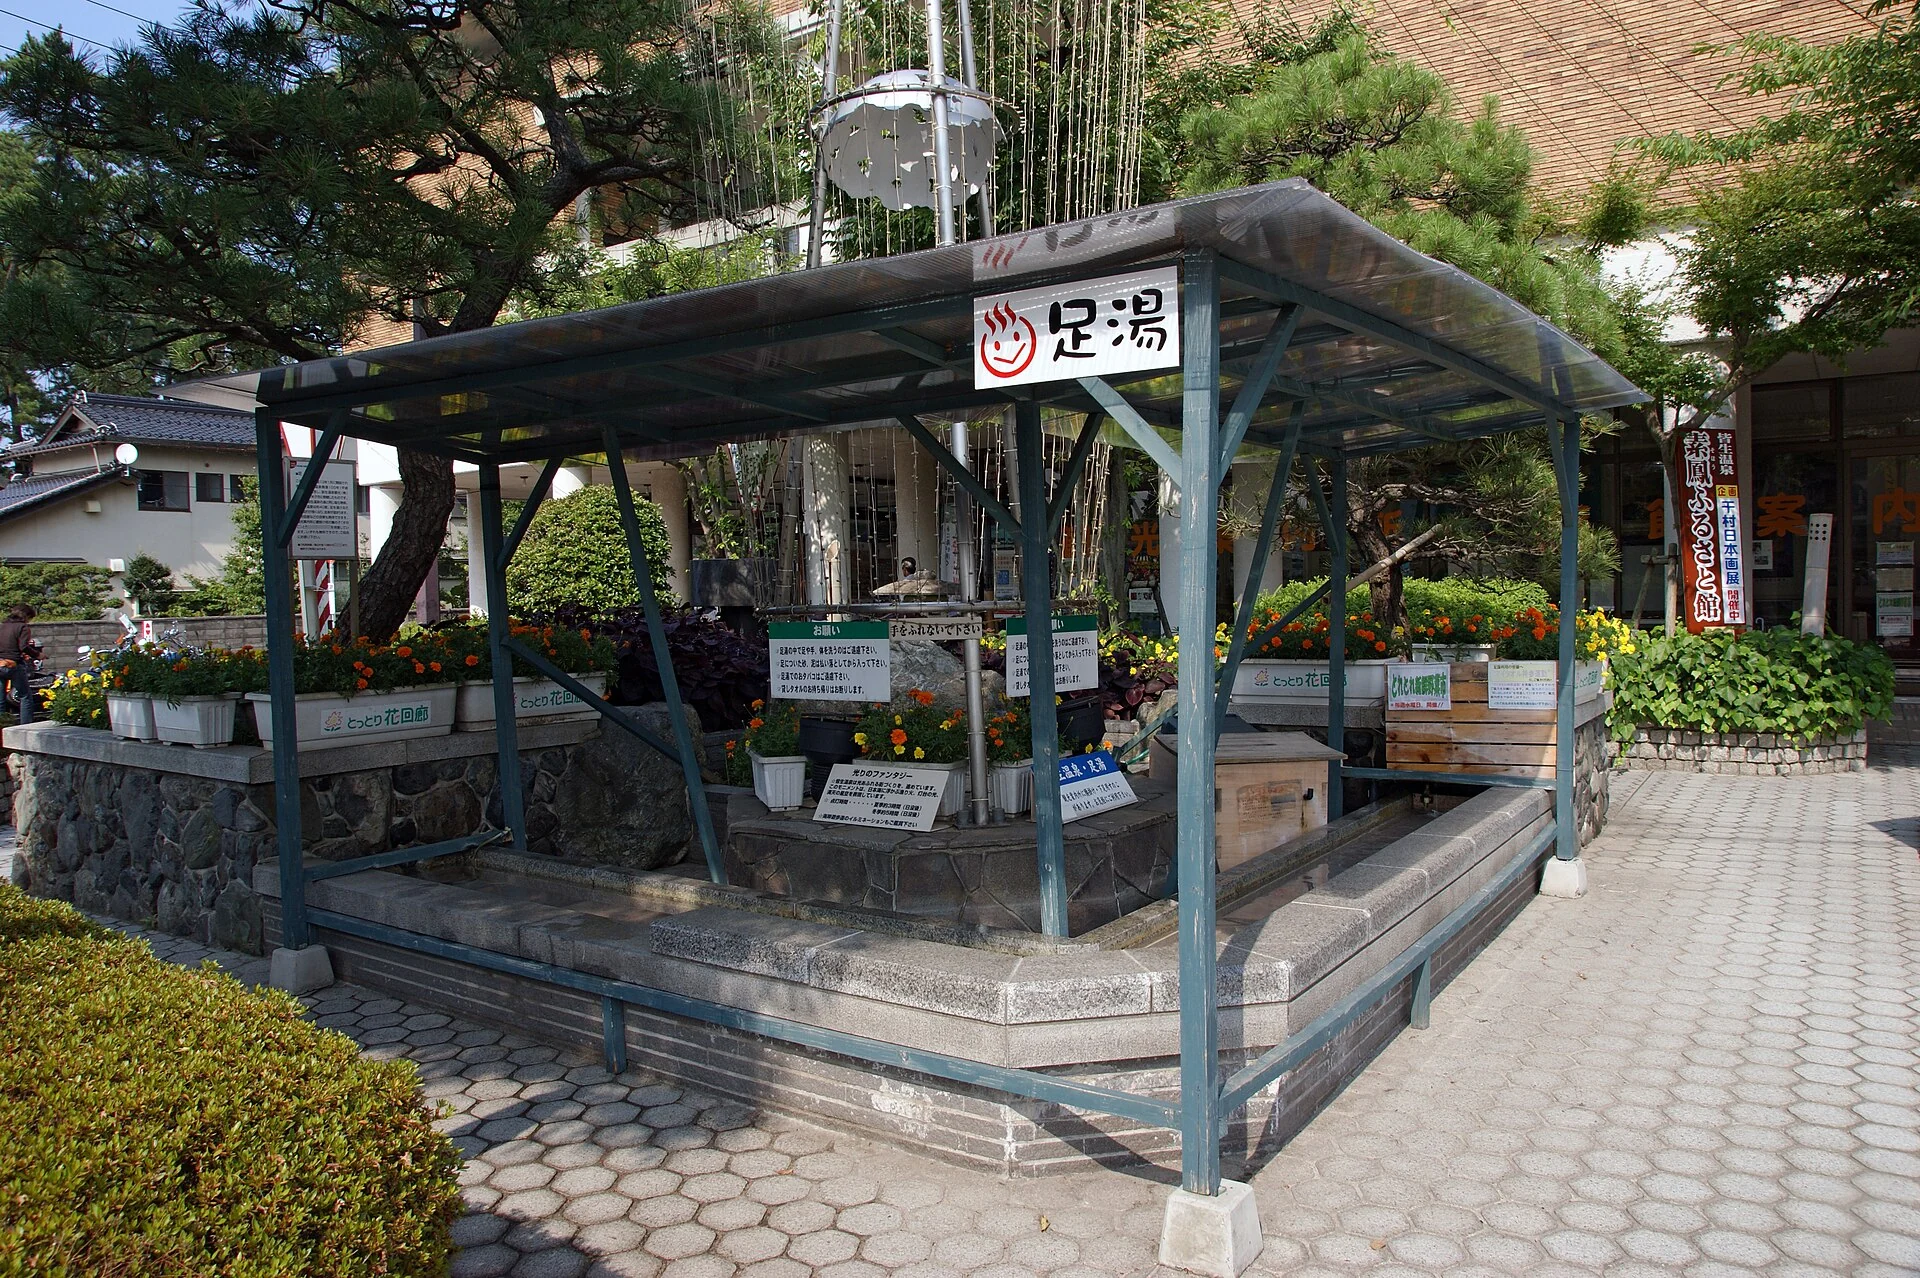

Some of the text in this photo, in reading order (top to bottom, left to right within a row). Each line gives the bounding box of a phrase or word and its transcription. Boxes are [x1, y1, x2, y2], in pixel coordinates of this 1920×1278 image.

[1049, 288, 1168, 362] 足湯
[1717, 432, 1735, 476] 皆生温泉
[1717, 487, 1738, 497] 企画
[1684, 431, 1721, 622] 素鳳ふるさと館
[1727, 589, 1740, 621] 開催中
[813, 624, 841, 636] お願い
[890, 624, 980, 637] 手をふれないで下さい
[347, 705, 429, 729] とっとり花回廊
[852, 769, 913, 779] 光りのファンタジー
